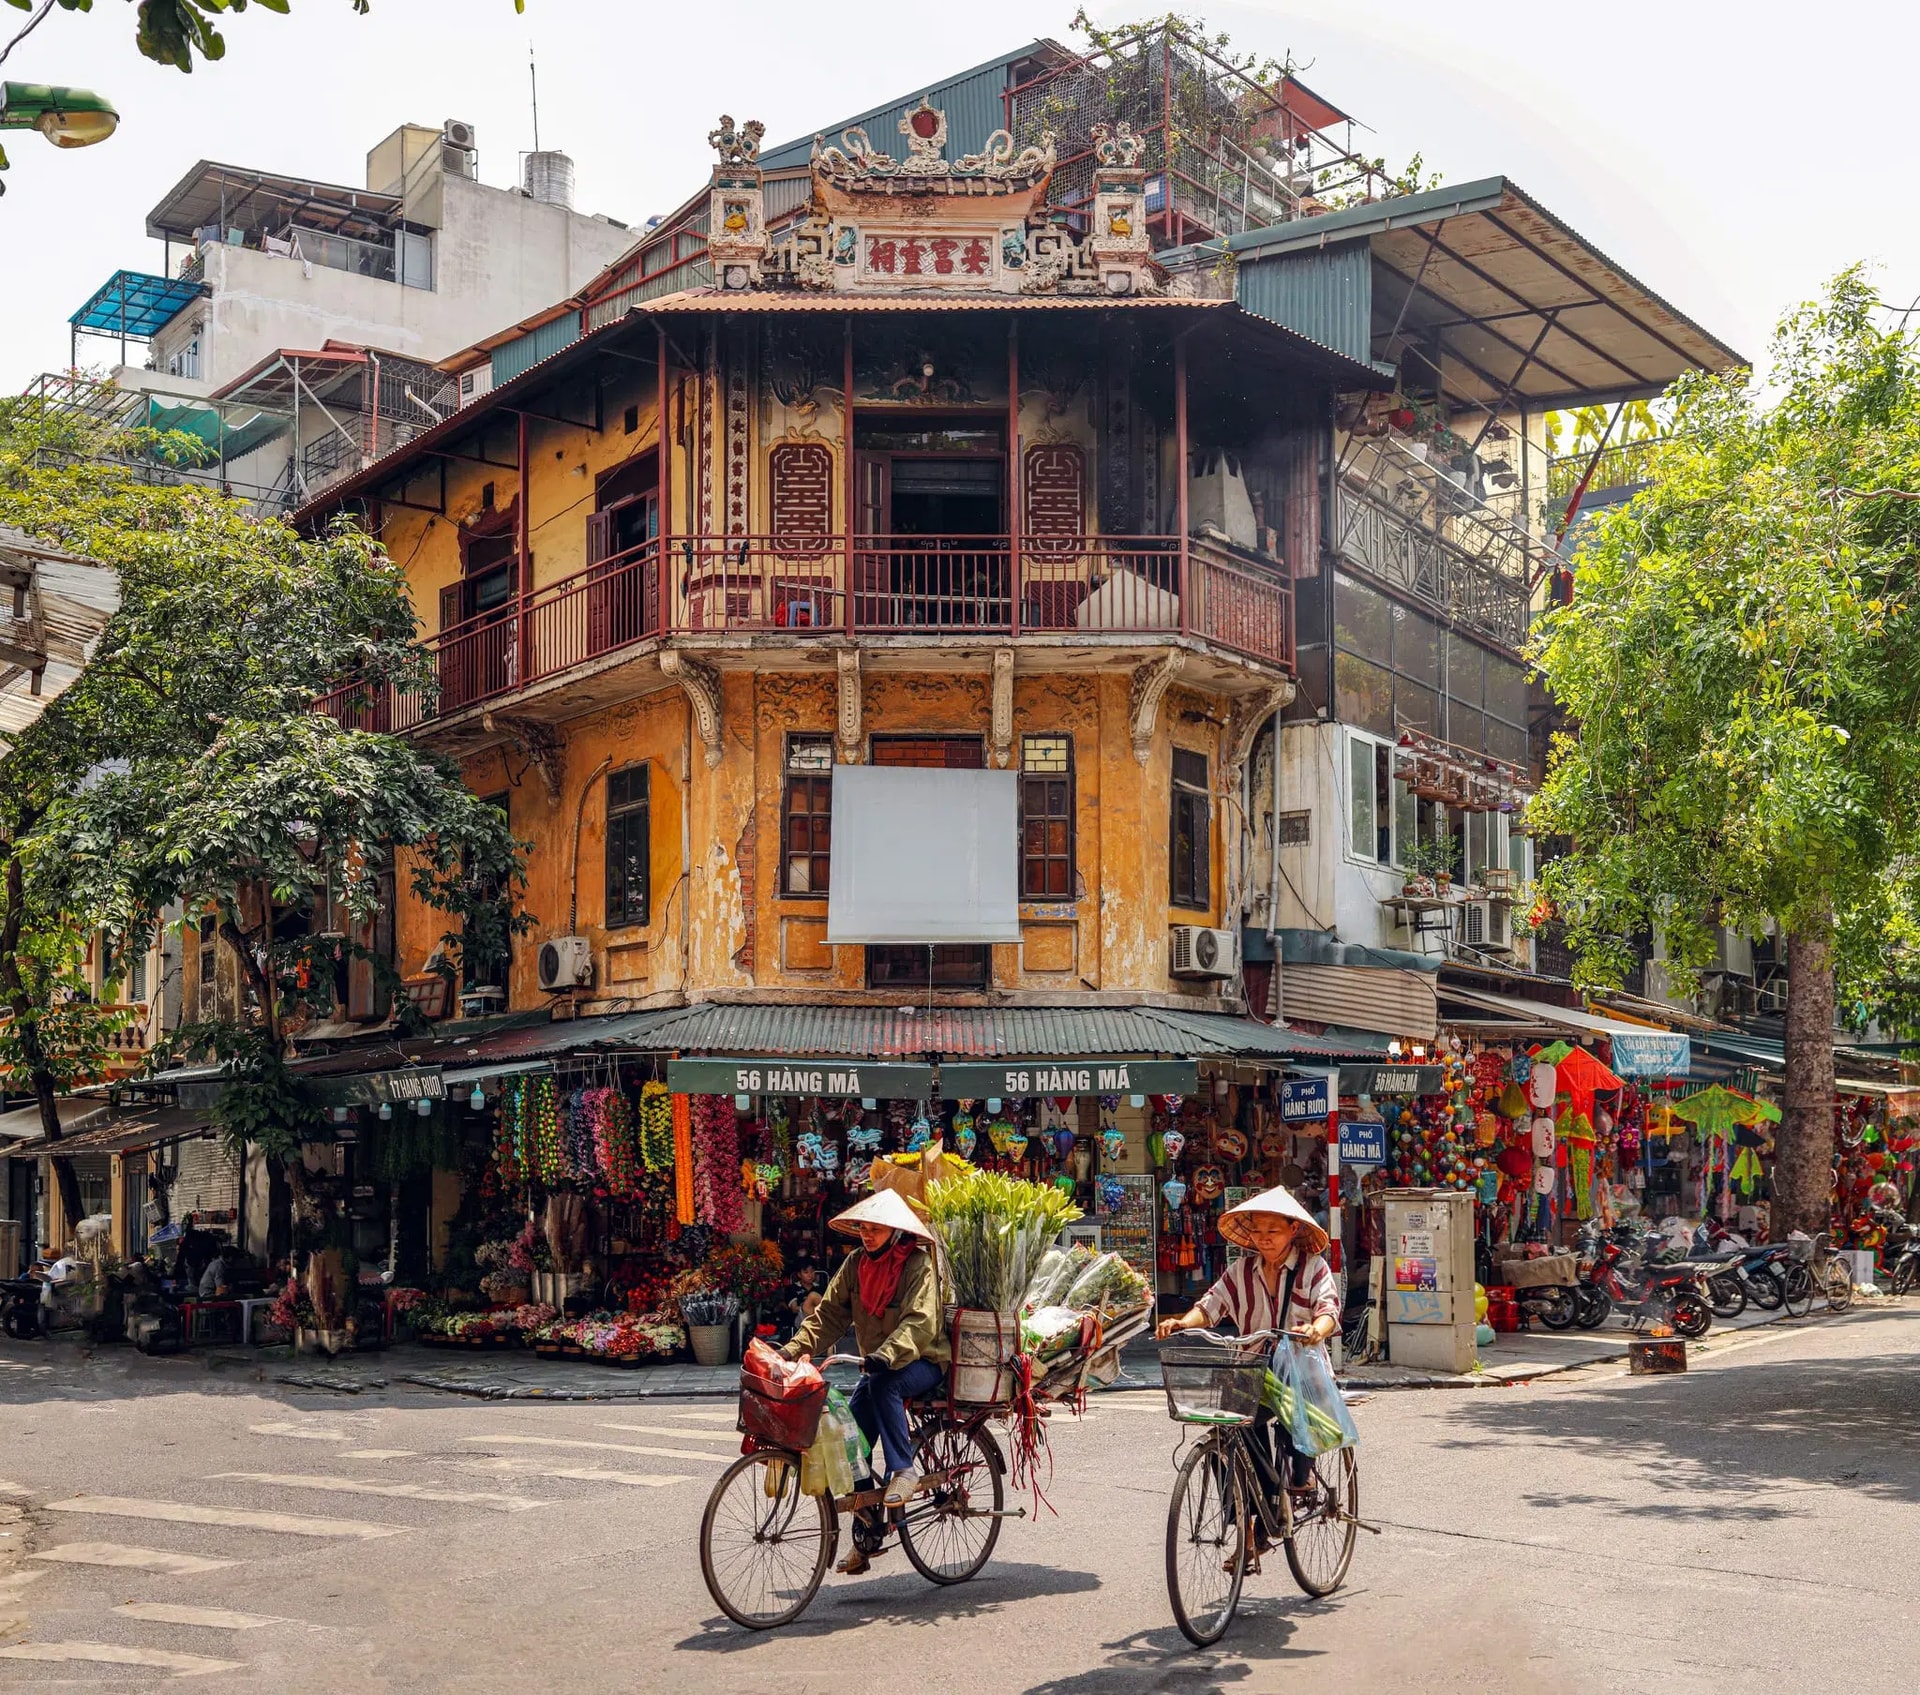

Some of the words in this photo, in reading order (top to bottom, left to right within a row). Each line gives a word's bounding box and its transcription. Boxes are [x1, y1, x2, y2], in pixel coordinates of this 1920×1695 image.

[389, 1080, 401, 1098] 17
[399, 1074, 422, 1098] HÀNG
[736, 1070, 761, 1091] 56
[767, 1066, 823, 1092] HÀNG
[828, 1068, 860, 1094] MÃ
[1006, 1071, 1029, 1092] 56
[1036, 1066, 1090, 1092] HÀNG
[1098, 1064, 1131, 1090] MÃ
[1375, 1072, 1386, 1092] 56
[1384, 1068, 1407, 1092] HÀNG
[1300, 1084, 1316, 1096] PHỐ
[1284, 1098, 1306, 1117] HÀNG
[1358, 1128, 1373, 1139] PHỐ
[1342, 1139, 1366, 1158] HÀNG
[1367, 1141, 1381, 1159] MÃ
